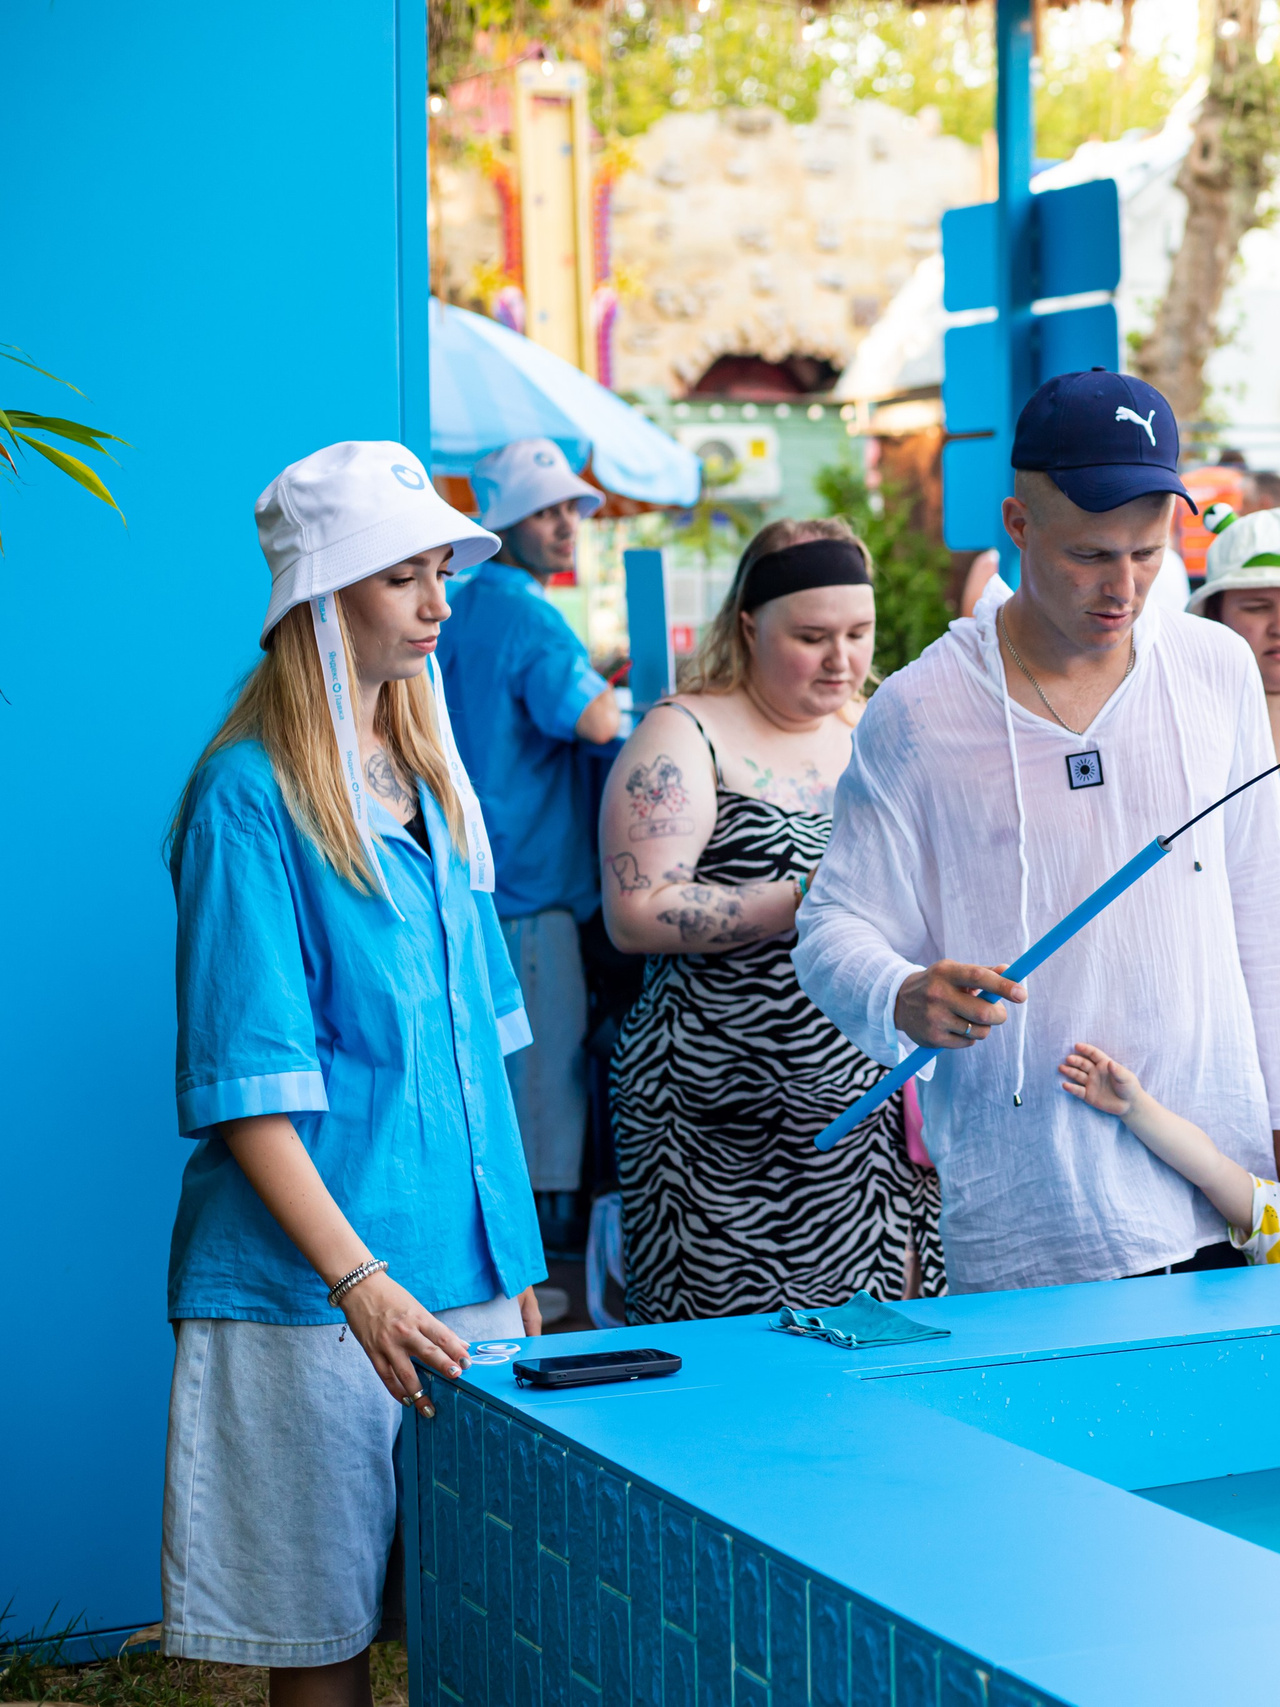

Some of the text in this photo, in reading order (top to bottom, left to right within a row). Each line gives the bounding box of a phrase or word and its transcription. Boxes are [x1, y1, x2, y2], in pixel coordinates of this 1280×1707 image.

[328, 651, 344, 720] Яндекс Лавка
[346, 750, 362, 820] Яндекс Лавка
